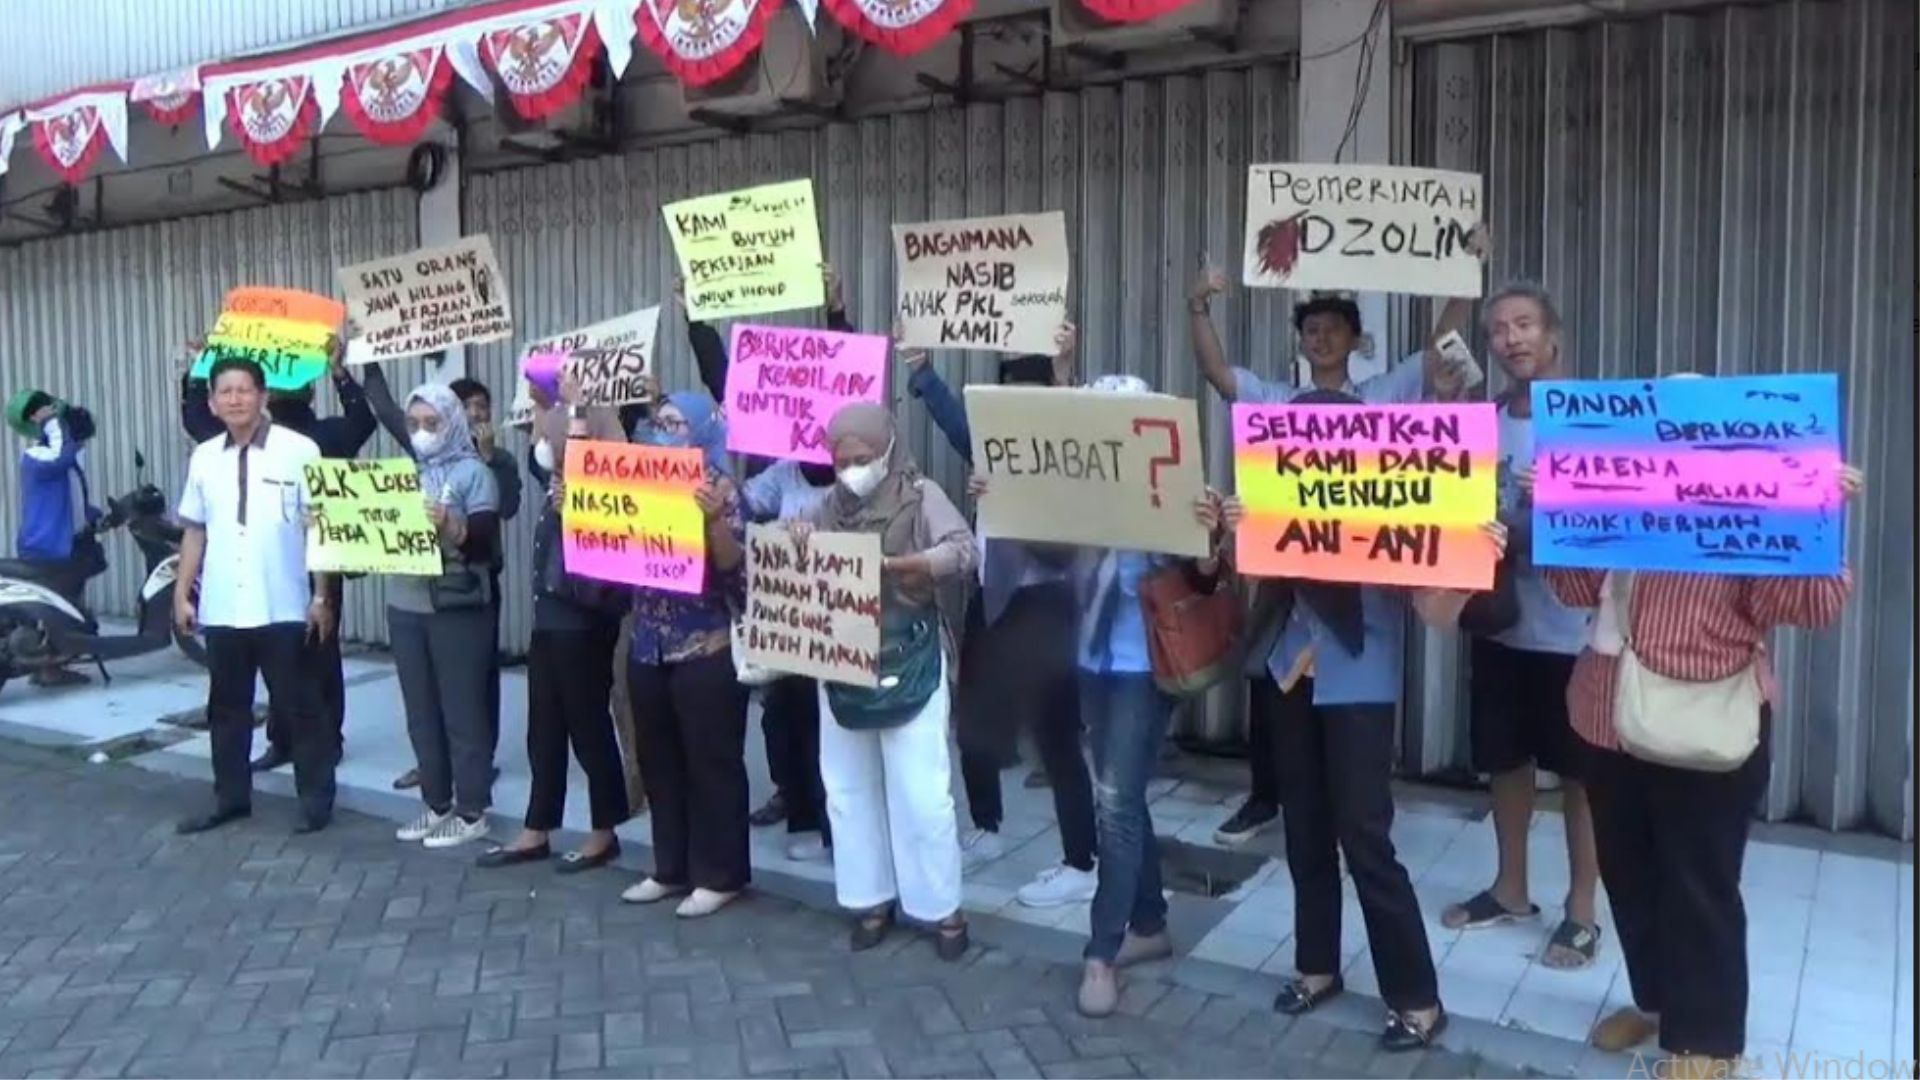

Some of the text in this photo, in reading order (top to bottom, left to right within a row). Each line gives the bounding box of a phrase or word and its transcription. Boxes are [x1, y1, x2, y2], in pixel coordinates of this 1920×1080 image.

[675, 213, 727, 237] KAMI
[731, 227, 796, 248] BUTUH
[904, 224, 1034, 262] BAGAIMANA
[360, 250, 477, 290] SATU ORANG
[690, 252, 775, 280] PEKERJAAN
[946, 260, 1016, 291] NASIB
[739, 282, 787, 299] HIDUP
[900, 288, 948, 318] ANAK
[955, 290, 1004, 318] PKL
[736, 329, 846, 363] BERIKAN
[940, 318, 1014, 347] KAMI?
[736, 391, 816, 421] UNTUK
[984, 437, 1124, 483] PEJABAT
[1379, 447, 1471, 478] DARI
[1550, 453, 1680, 479] KARENA
[303, 464, 359, 499] BLK
[1297, 475, 1432, 510] MENUJU
[1675, 481, 1779, 502] KALIAN
[571, 487, 639, 517] NASIB
[1641, 510, 1761, 534] PERNAH
[1696, 532, 1803, 553] LAPAR
[750, 537, 791, 570] SAYA
[813, 549, 863, 579] KAMI
[752, 574, 813, 604] ADALAH
[749, 625, 880, 675] BUTUH MAKAN
